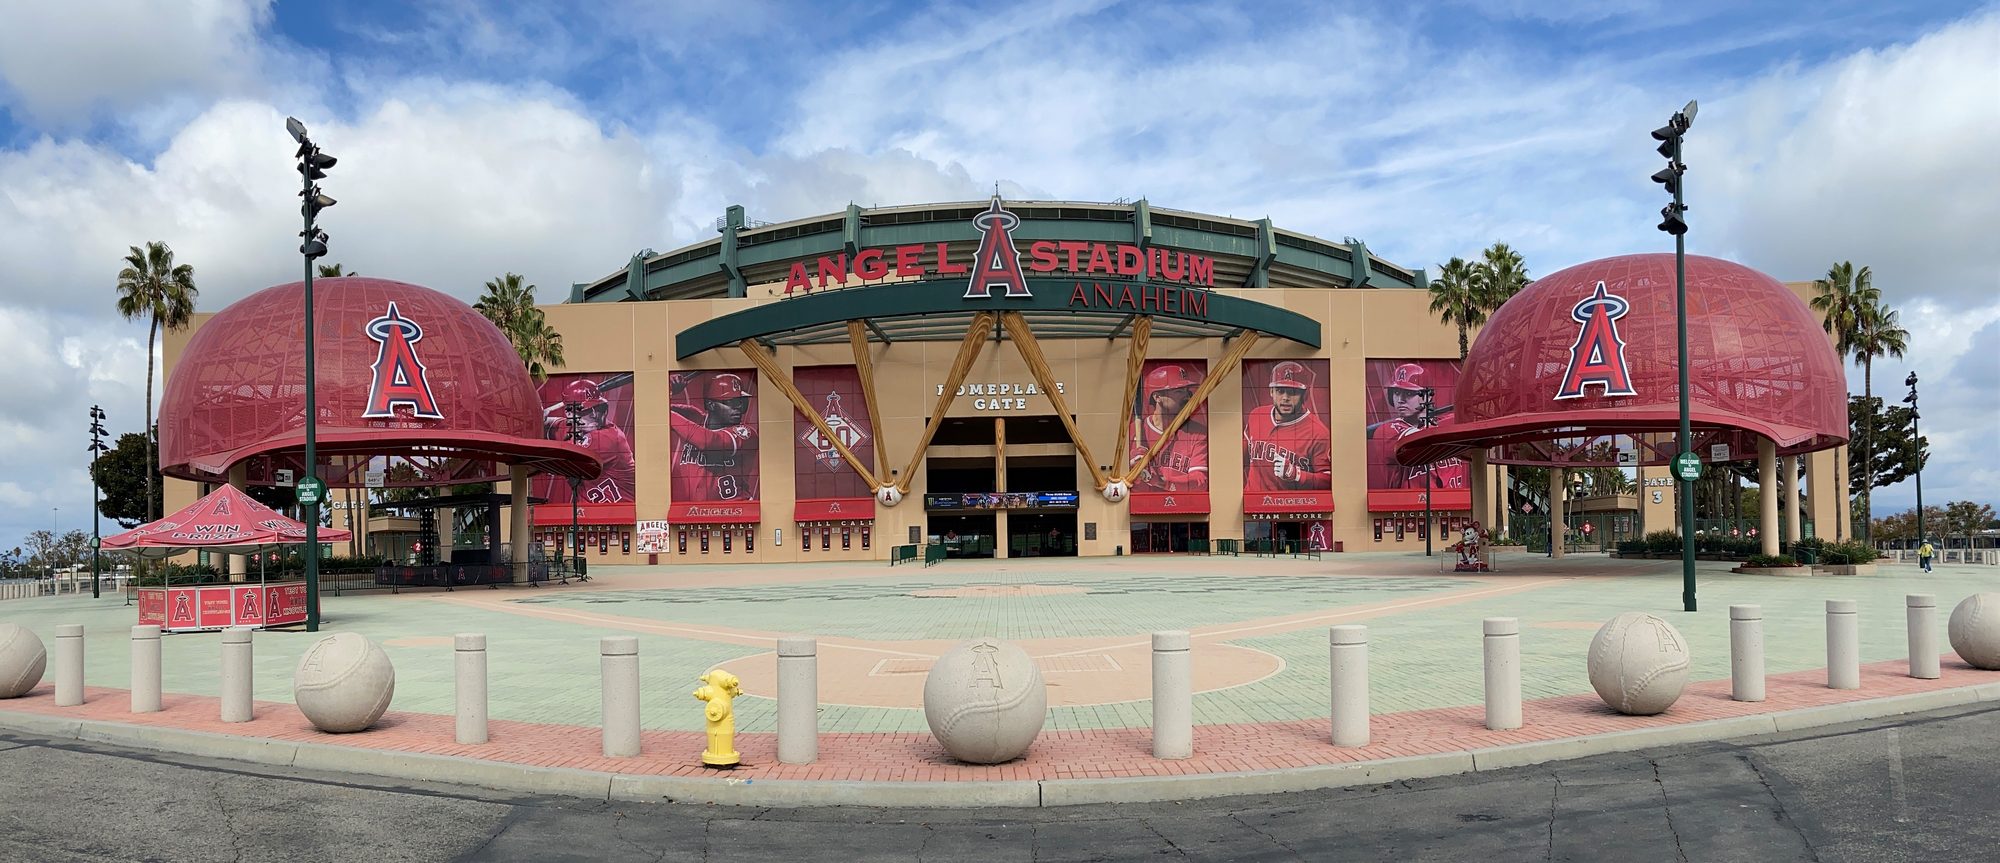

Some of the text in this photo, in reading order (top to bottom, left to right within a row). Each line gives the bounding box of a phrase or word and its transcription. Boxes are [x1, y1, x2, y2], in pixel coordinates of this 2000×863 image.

[784, 242, 968, 295] ANGEL
[1030, 241, 1215, 287] STADIUM
[1069, 281, 1208, 317] ANAHEIM
[937, 382, 1064, 397] HOMEPLAE
[974, 398, 1026, 410] GATE
[718, 475, 737, 500] 8
[1644, 478, 1673, 488] GATE
[586, 478, 622, 503] 27
[1263, 495, 1317, 505] ANGELS
[1652, 490, 1663, 504] 3
[686, 506, 743, 517] ANGELS
[194, 524, 241, 533] WIN
[640, 521, 668, 531] ANGELS
[1584, 523, 1590, 532] 3
[171, 530, 254, 540] PRIZES
[415, 543, 421, 551] 2
[299, 585, 307, 594] YO
[283, 606, 307, 616] KNOWLE
